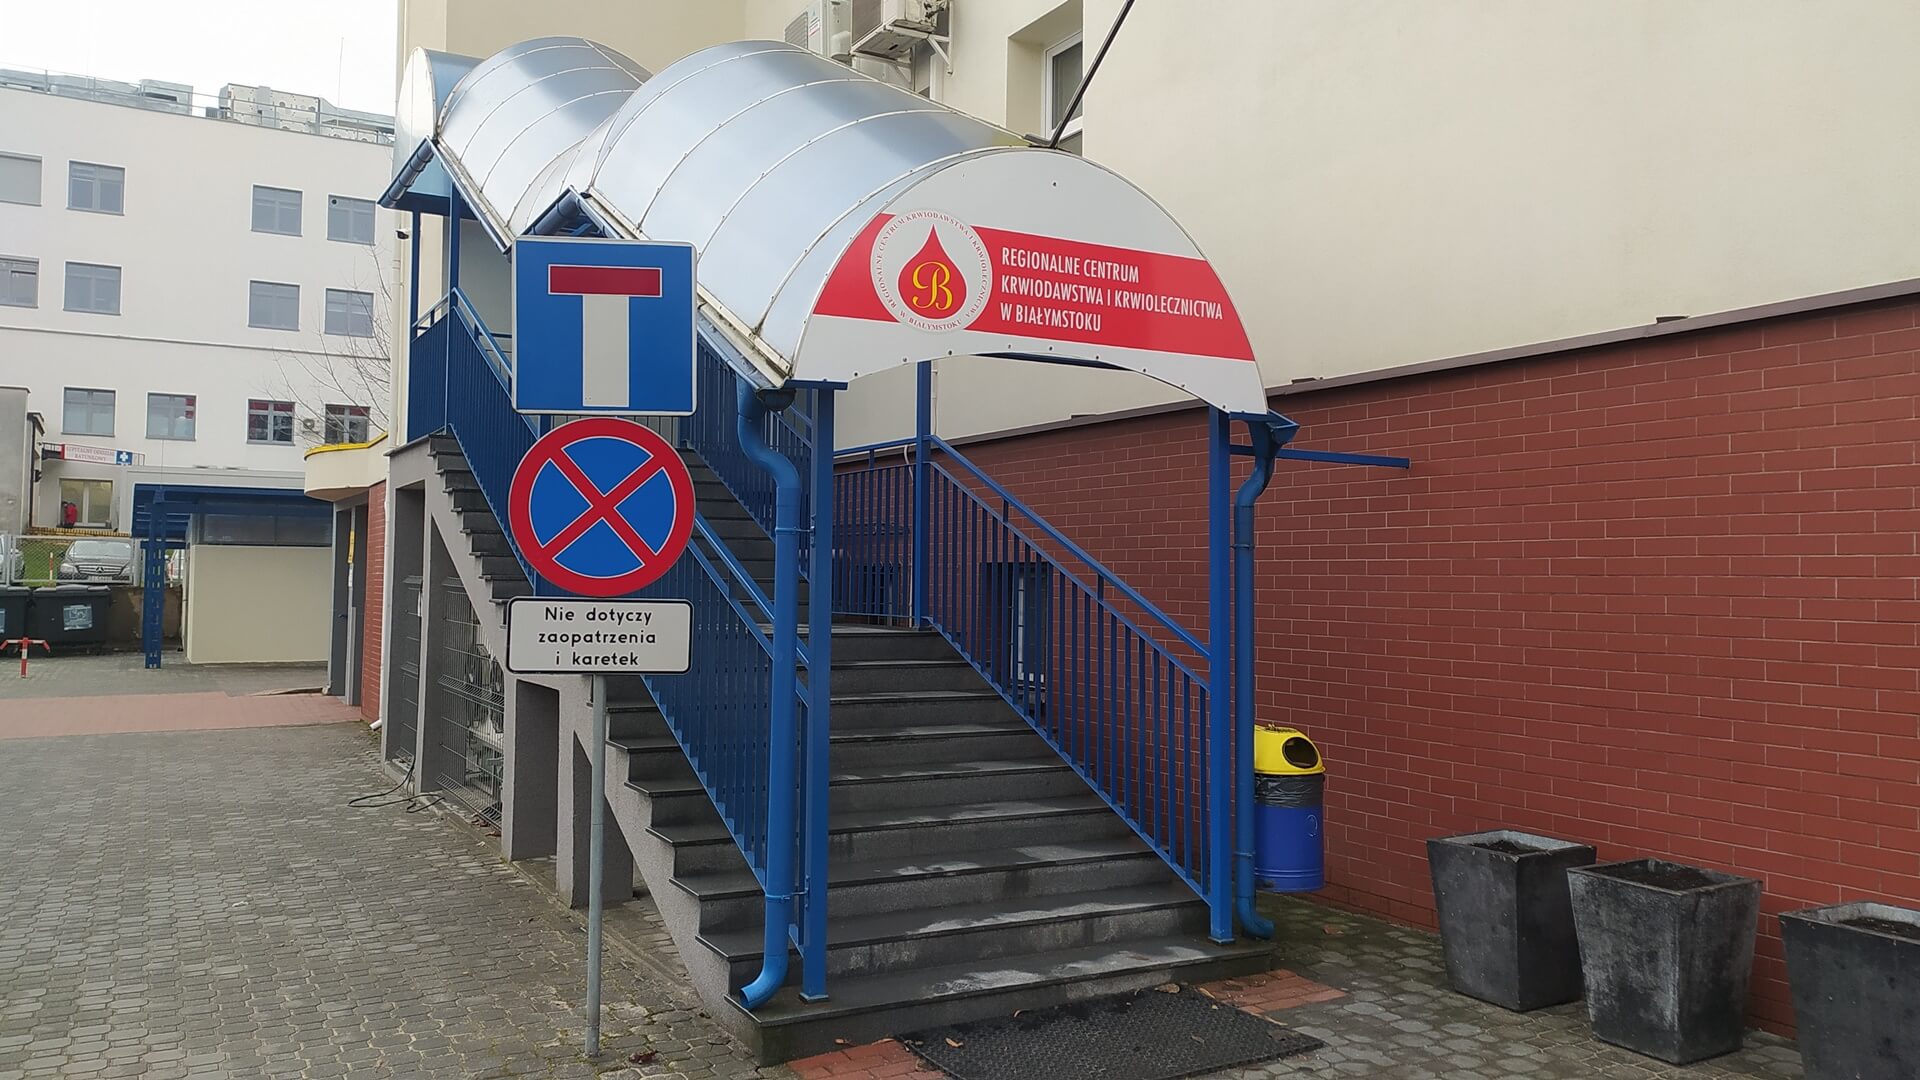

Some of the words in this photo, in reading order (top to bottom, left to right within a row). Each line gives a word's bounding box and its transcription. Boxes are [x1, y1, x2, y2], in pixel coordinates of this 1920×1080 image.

[906, 211, 969, 236] KRWIODAWSTWA
[1002, 247, 1080, 275] REGIONALNE
[1084, 259, 1139, 283] CENTRUM
[1001, 275, 1103, 305] KRWIODAWSTWA
[1107, 289, 1111, 305] I
[1115, 290, 1223, 320] KRWIOLECZNICTWA
[1000, 302, 1012, 321] W
[1015, 304, 1101, 332] BIAŁYMSTOKU
[545, 607, 575, 621] Nie
[586, 607, 652, 626] dotyczy
[538, 630, 656, 647] zaopatrzenia
[556, 651, 560, 665] i
[572, 652, 639, 666] karetek
